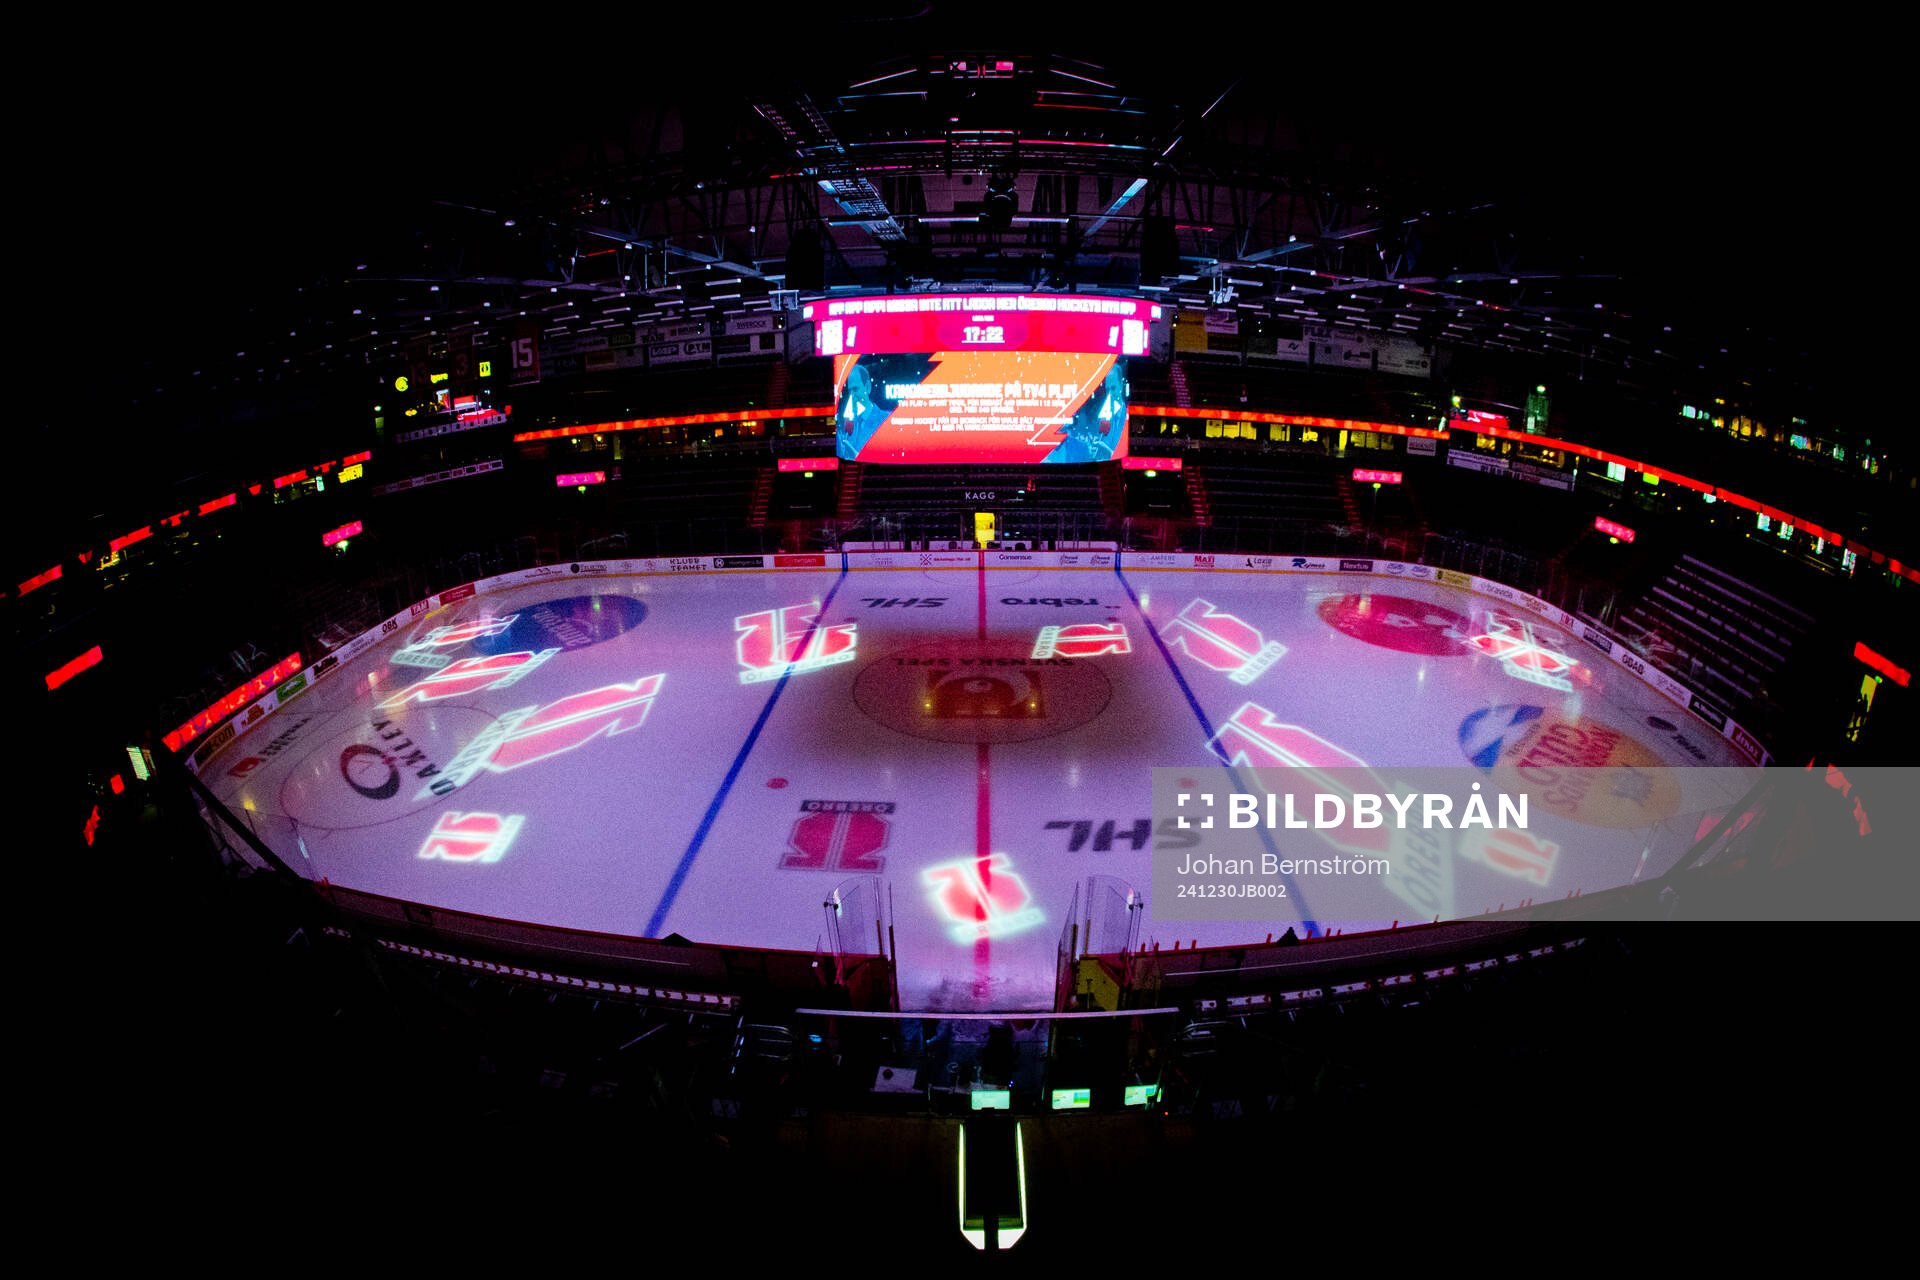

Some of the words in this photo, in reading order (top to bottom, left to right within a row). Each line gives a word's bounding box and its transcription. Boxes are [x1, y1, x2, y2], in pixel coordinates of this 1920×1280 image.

[963, 326, 1004, 342] 17:22
[510, 337, 533, 369] 15
[1023, 384, 1046, 398] TV4
[965, 491, 995, 500] KAGG
[671, 564, 707, 572] TEAMET
[860, 598, 949, 608] SHL
[372, 719, 457, 796] OAKLEY
[1043, 817, 1203, 852] SHL
